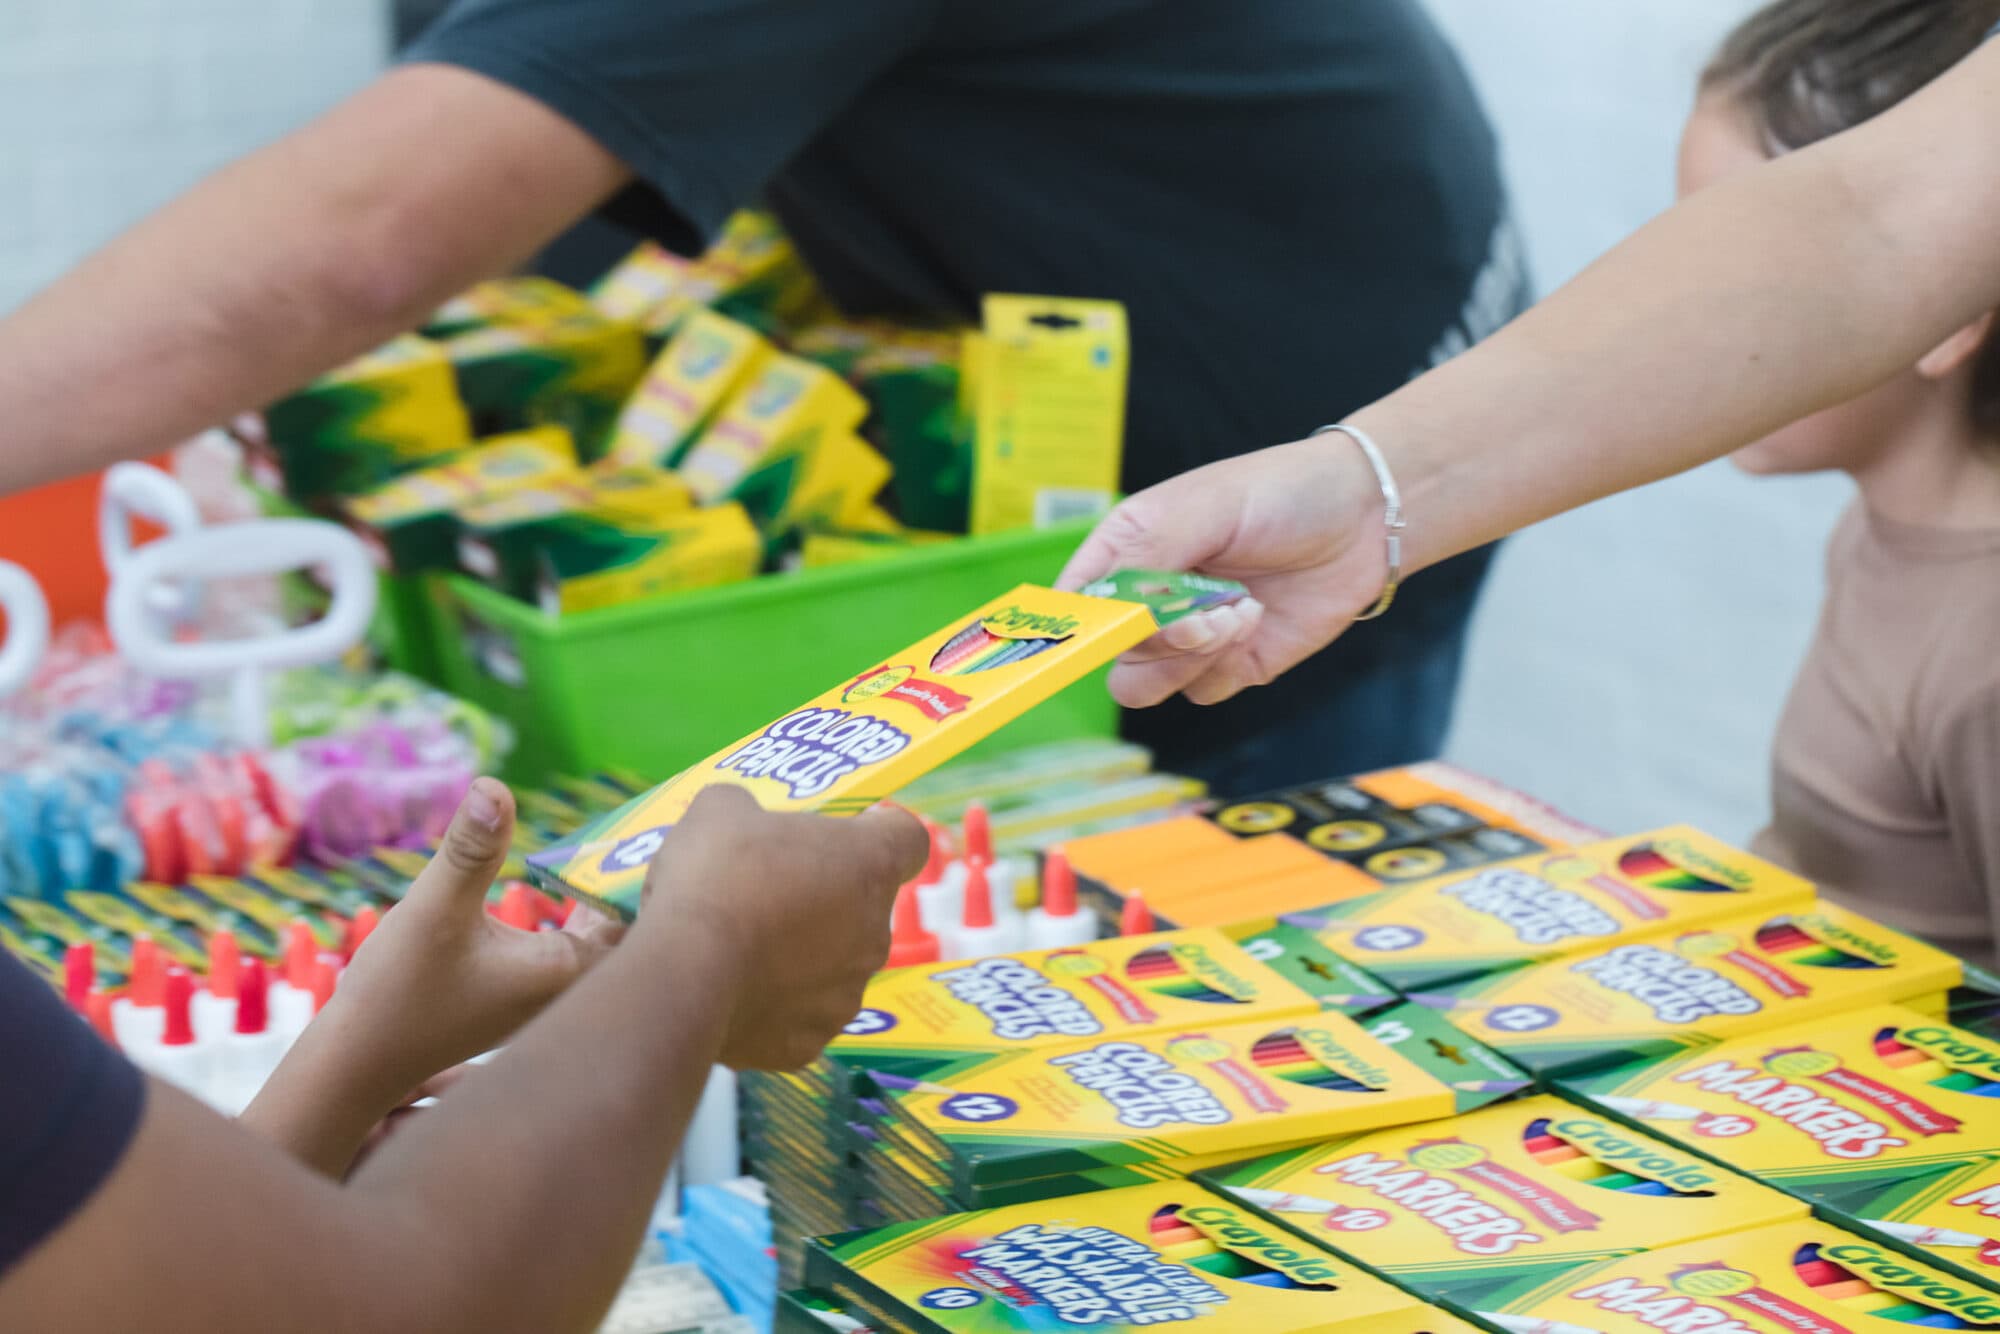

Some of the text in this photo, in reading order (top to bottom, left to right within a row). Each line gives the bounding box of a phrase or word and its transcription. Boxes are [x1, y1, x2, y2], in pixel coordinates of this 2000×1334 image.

[984, 605, 1080, 636] Crayola
[715, 736, 857, 799] PENCILS
[766, 708, 911, 765] COLORED
[928, 967, 1057, 1039] PENCILS
[975, 958, 1104, 1036] COLORED
[1047, 1050, 1183, 1128] PENCILS
[1097, 1042, 1233, 1125] COLORED
[1300, 1028, 1392, 1085] Crayola
[950, 1096, 1006, 1119] 12
[1673, 1060, 1908, 1159] MARKERS
[1698, 1115, 1752, 1136] 10
[1556, 1120, 1714, 1188] Crayola
[1314, 1152, 1543, 1255] MARKERS
[1331, 1209, 1387, 1230] 10
[993, 1224, 1195, 1326] WASHABLE
[1072, 1226, 1231, 1306] ULTRA-CLEAN
[1186, 1206, 1338, 1281] Crayola
[924, 1288, 980, 1309] 10
[958, 1244, 1123, 1325] MARKERS
[1569, 1277, 1760, 1334] MARK
[1826, 1244, 2000, 1319] Crayola
